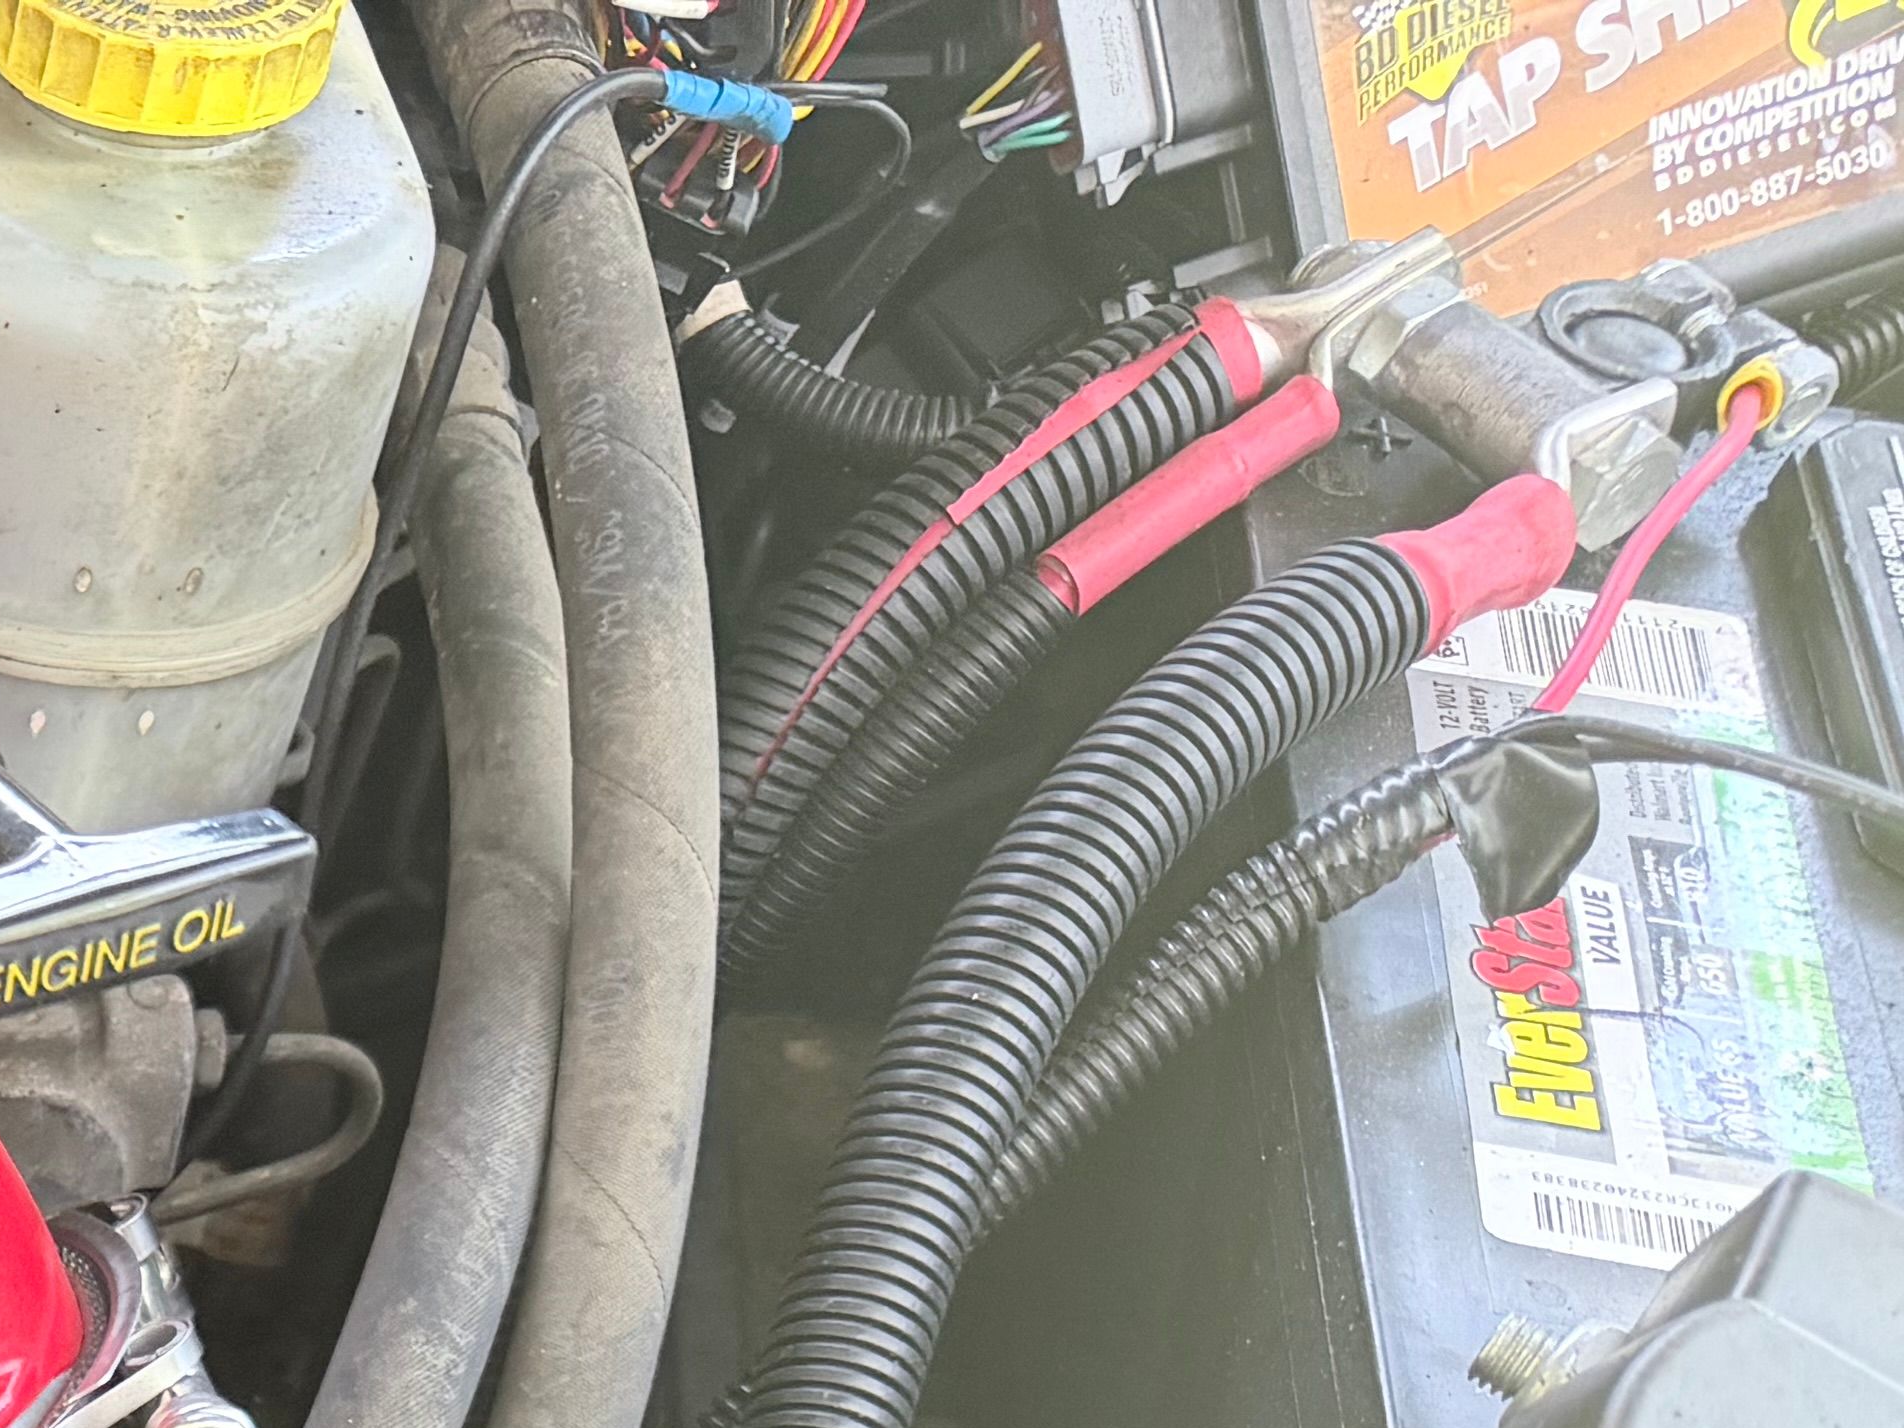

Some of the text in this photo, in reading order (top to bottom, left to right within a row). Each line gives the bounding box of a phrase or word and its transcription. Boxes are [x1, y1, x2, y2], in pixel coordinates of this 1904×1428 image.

[1359, 12, 1512, 119] PERFORMANCE
[1647, 61, 1832, 144] INNOVATION
[1387, 35, 1562, 192] TAP
[1652, 69, 1894, 172] BY COMPETITION
[1656, 141, 1887, 236] 1-800-887-5030
[1433, 681, 1461, 730] 12-VOLT
[1468, 685, 1490, 733] Battery
[172, 895, 245, 953] OIL
[1579, 885, 1623, 968] VALUE
